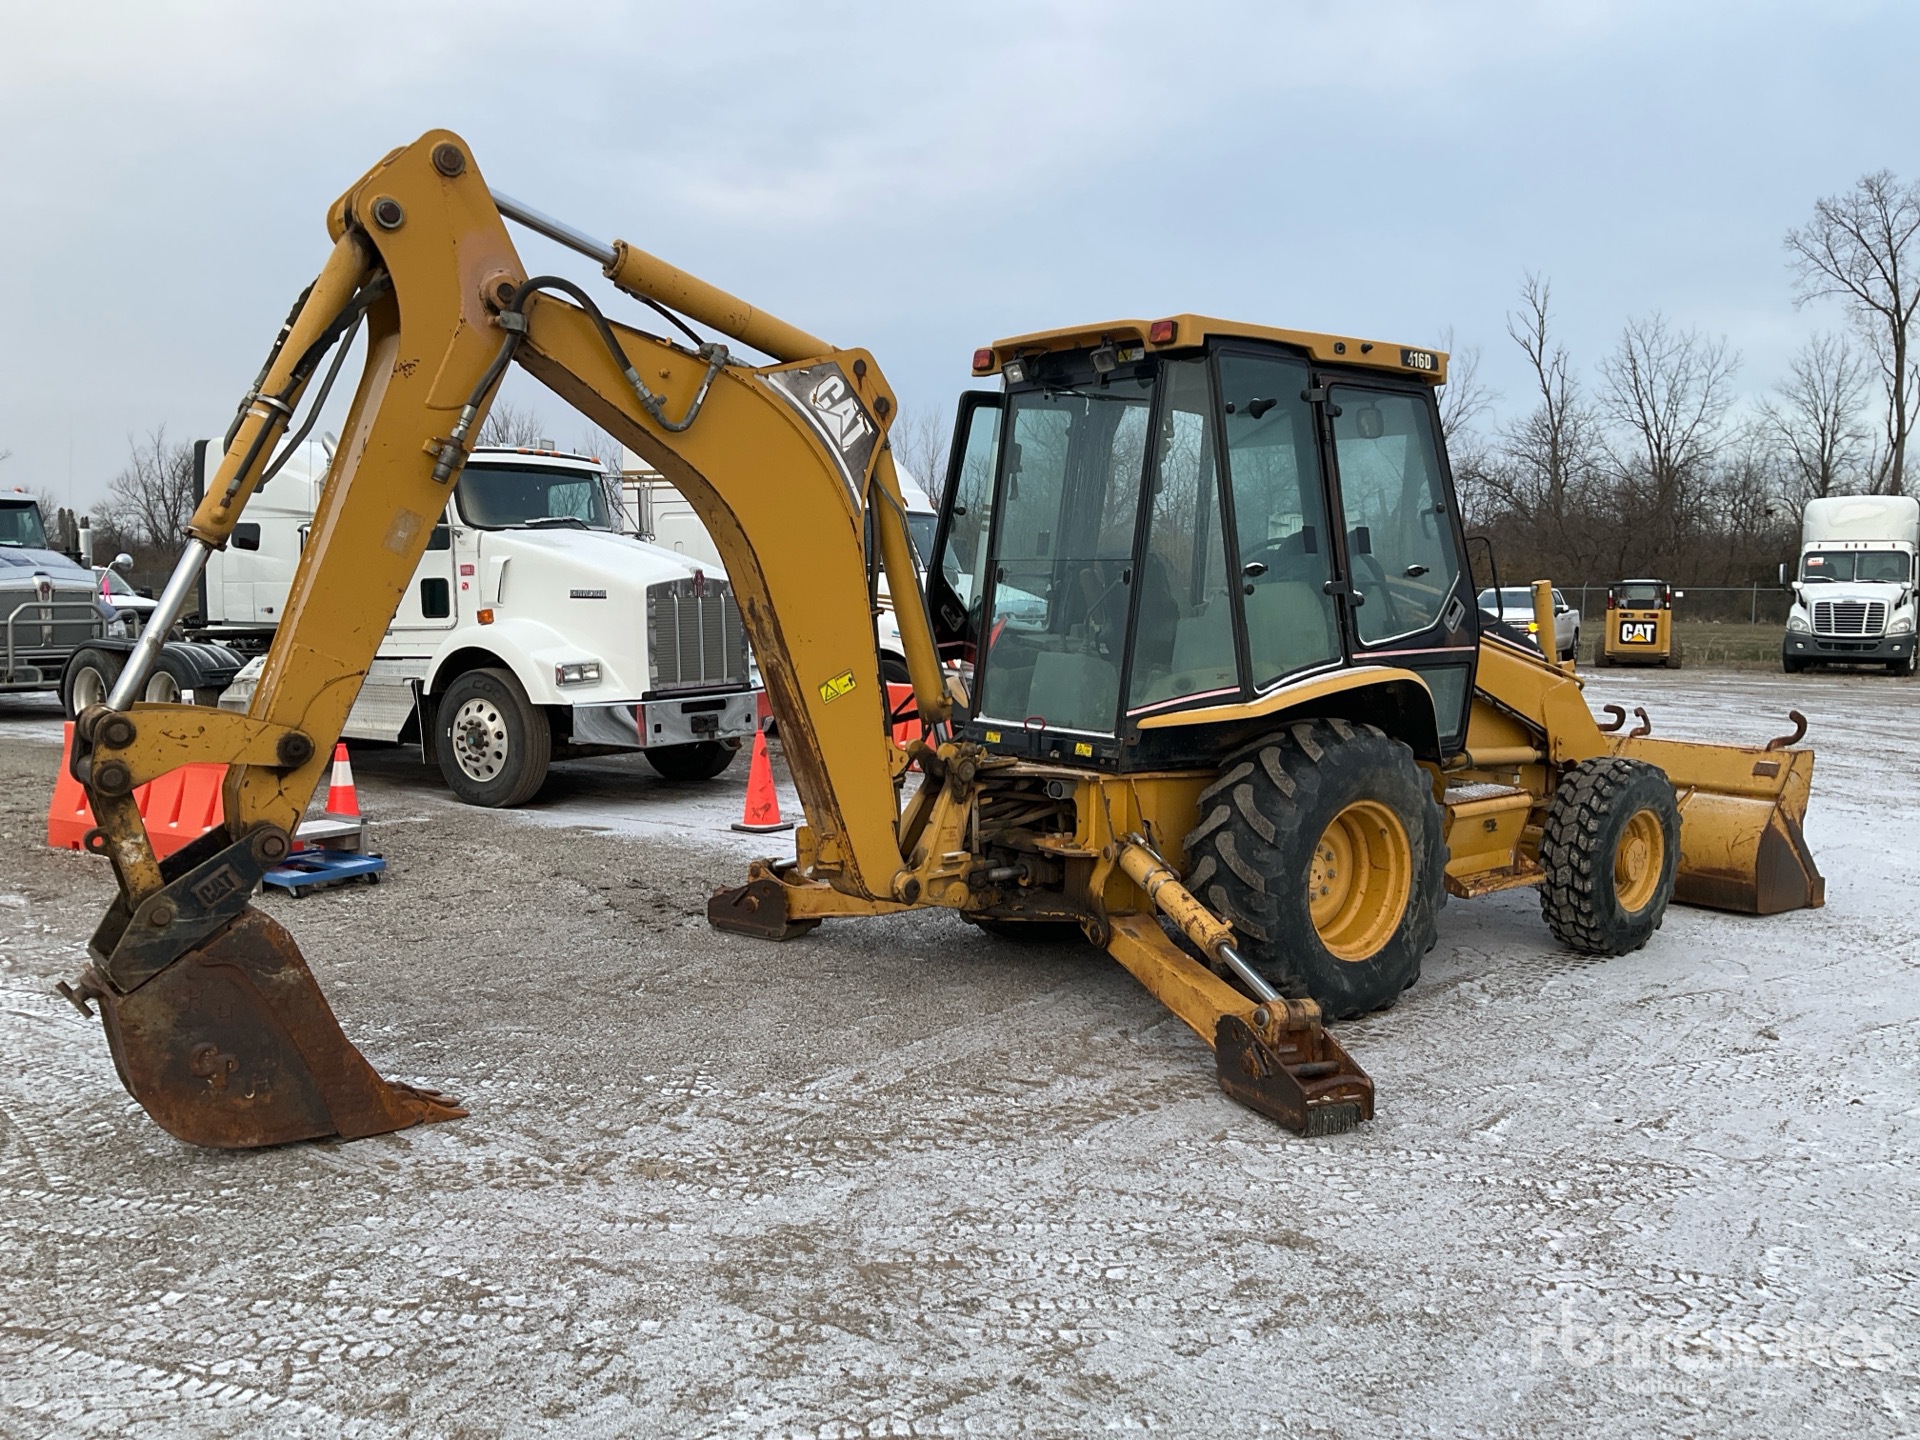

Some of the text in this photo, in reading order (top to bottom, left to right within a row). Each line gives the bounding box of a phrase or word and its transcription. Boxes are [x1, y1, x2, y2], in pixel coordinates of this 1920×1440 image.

[1407, 351, 1432, 370] 416D
[809, 375, 874, 453] CAT
[1621, 623, 1655, 642] CAT
[198, 870, 236, 905] CAT
